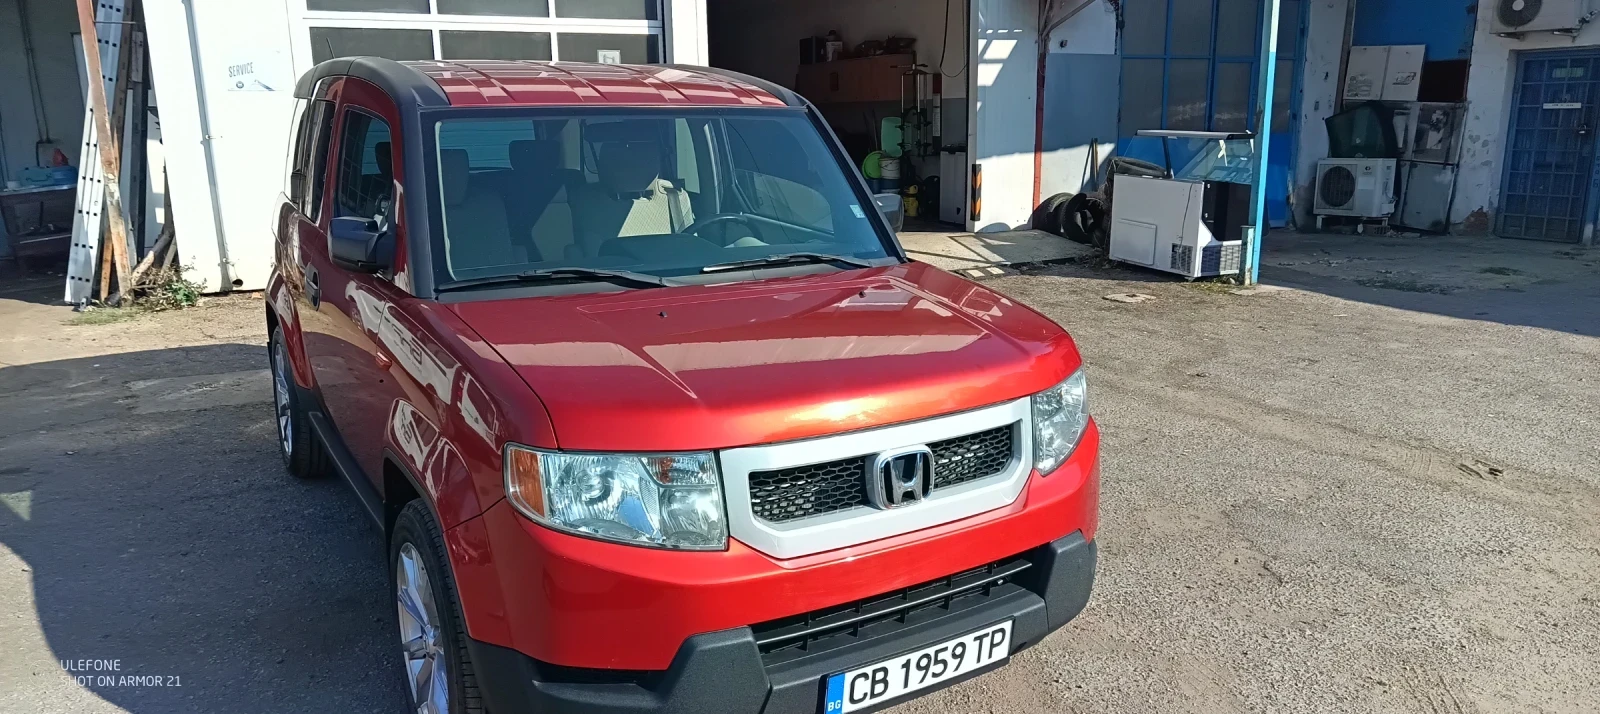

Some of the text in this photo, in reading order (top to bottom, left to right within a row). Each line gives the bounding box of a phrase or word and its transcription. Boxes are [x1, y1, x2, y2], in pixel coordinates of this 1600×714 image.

[228, 61, 254, 78] SERVICE
[848, 627, 1007, 705] CB 1959 TP
[827, 699, 842, 712] BG
